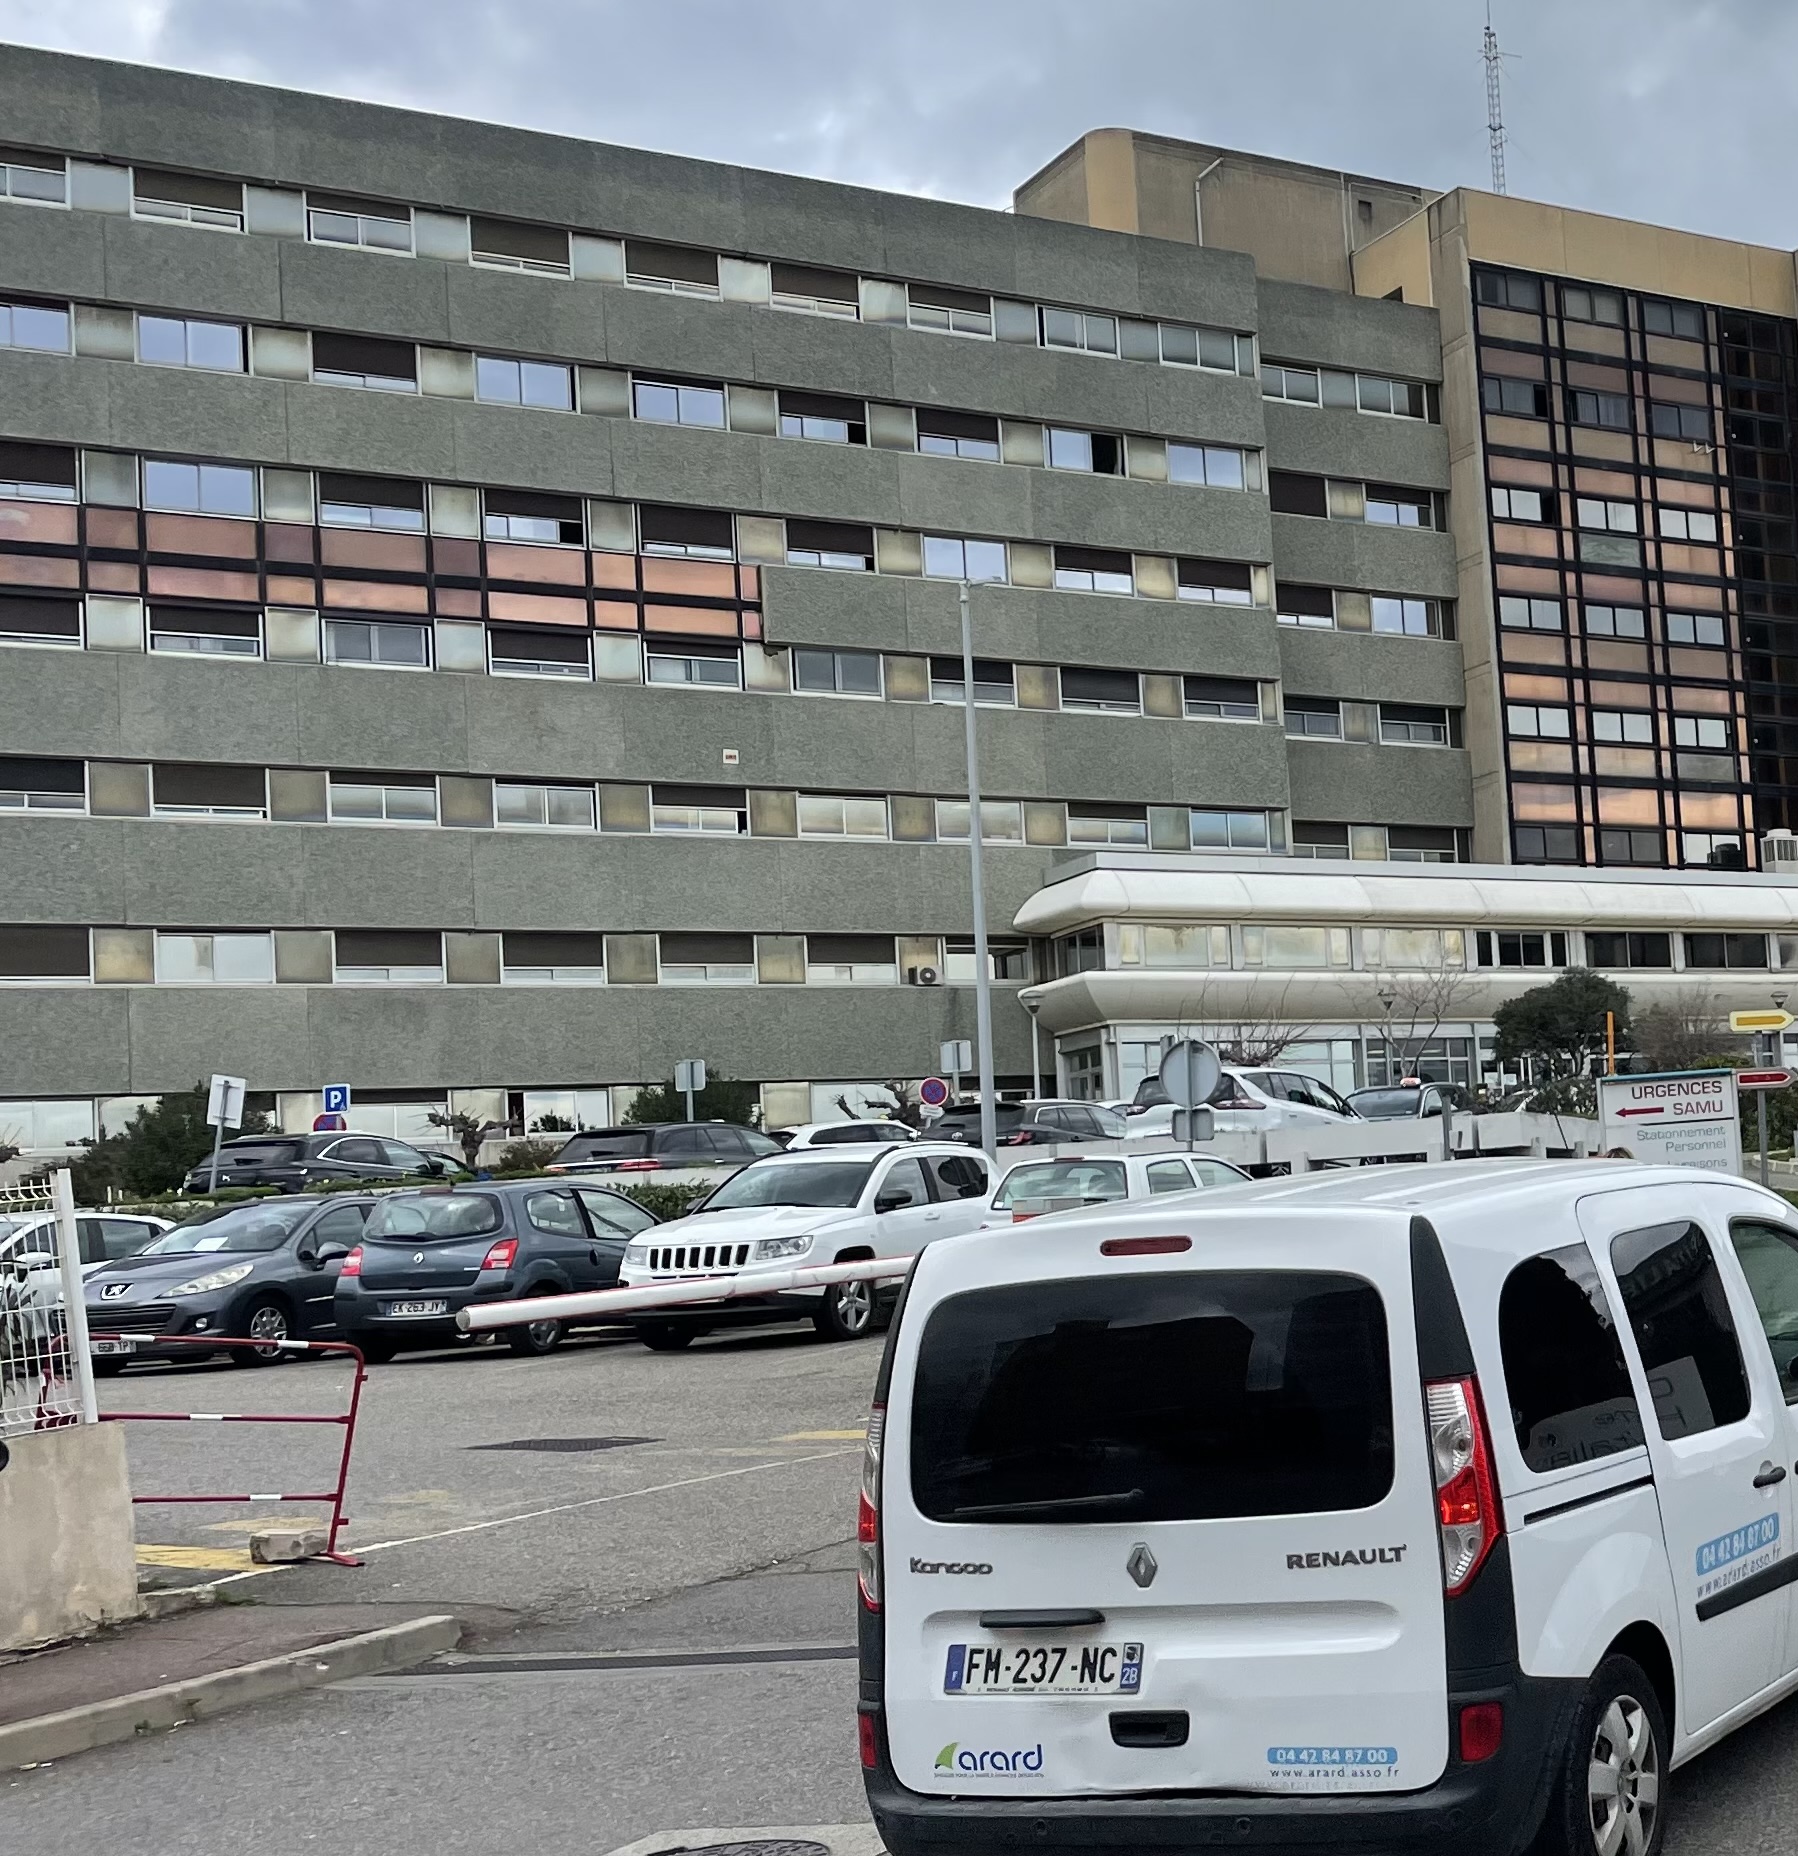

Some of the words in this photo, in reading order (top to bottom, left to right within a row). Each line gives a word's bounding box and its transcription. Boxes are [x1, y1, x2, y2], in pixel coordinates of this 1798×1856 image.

[1631, 1080, 1723, 1100] URGENCES
[330, 1090, 342, 1109] P
[1673, 1100, 1723, 1116] SAMU
[1636, 1126, 1726, 1141] Stationnement
[1665, 1139, 1727, 1153] Personnel
[1286, 1544, 1407, 1569] RENAULT
[910, 1557, 993, 1575] Kangoo
[1121, 1667, 1139, 1685] 2B
[958, 1744, 1043, 1771] arard
[1276, 1750, 1297, 1762] 04
[1299, 1750, 1317, 1763] 42
[1322, 1750, 1340, 1763] 84
[1345, 1750, 1362, 1763] 87
[1367, 1750, 1388, 1763] 00
